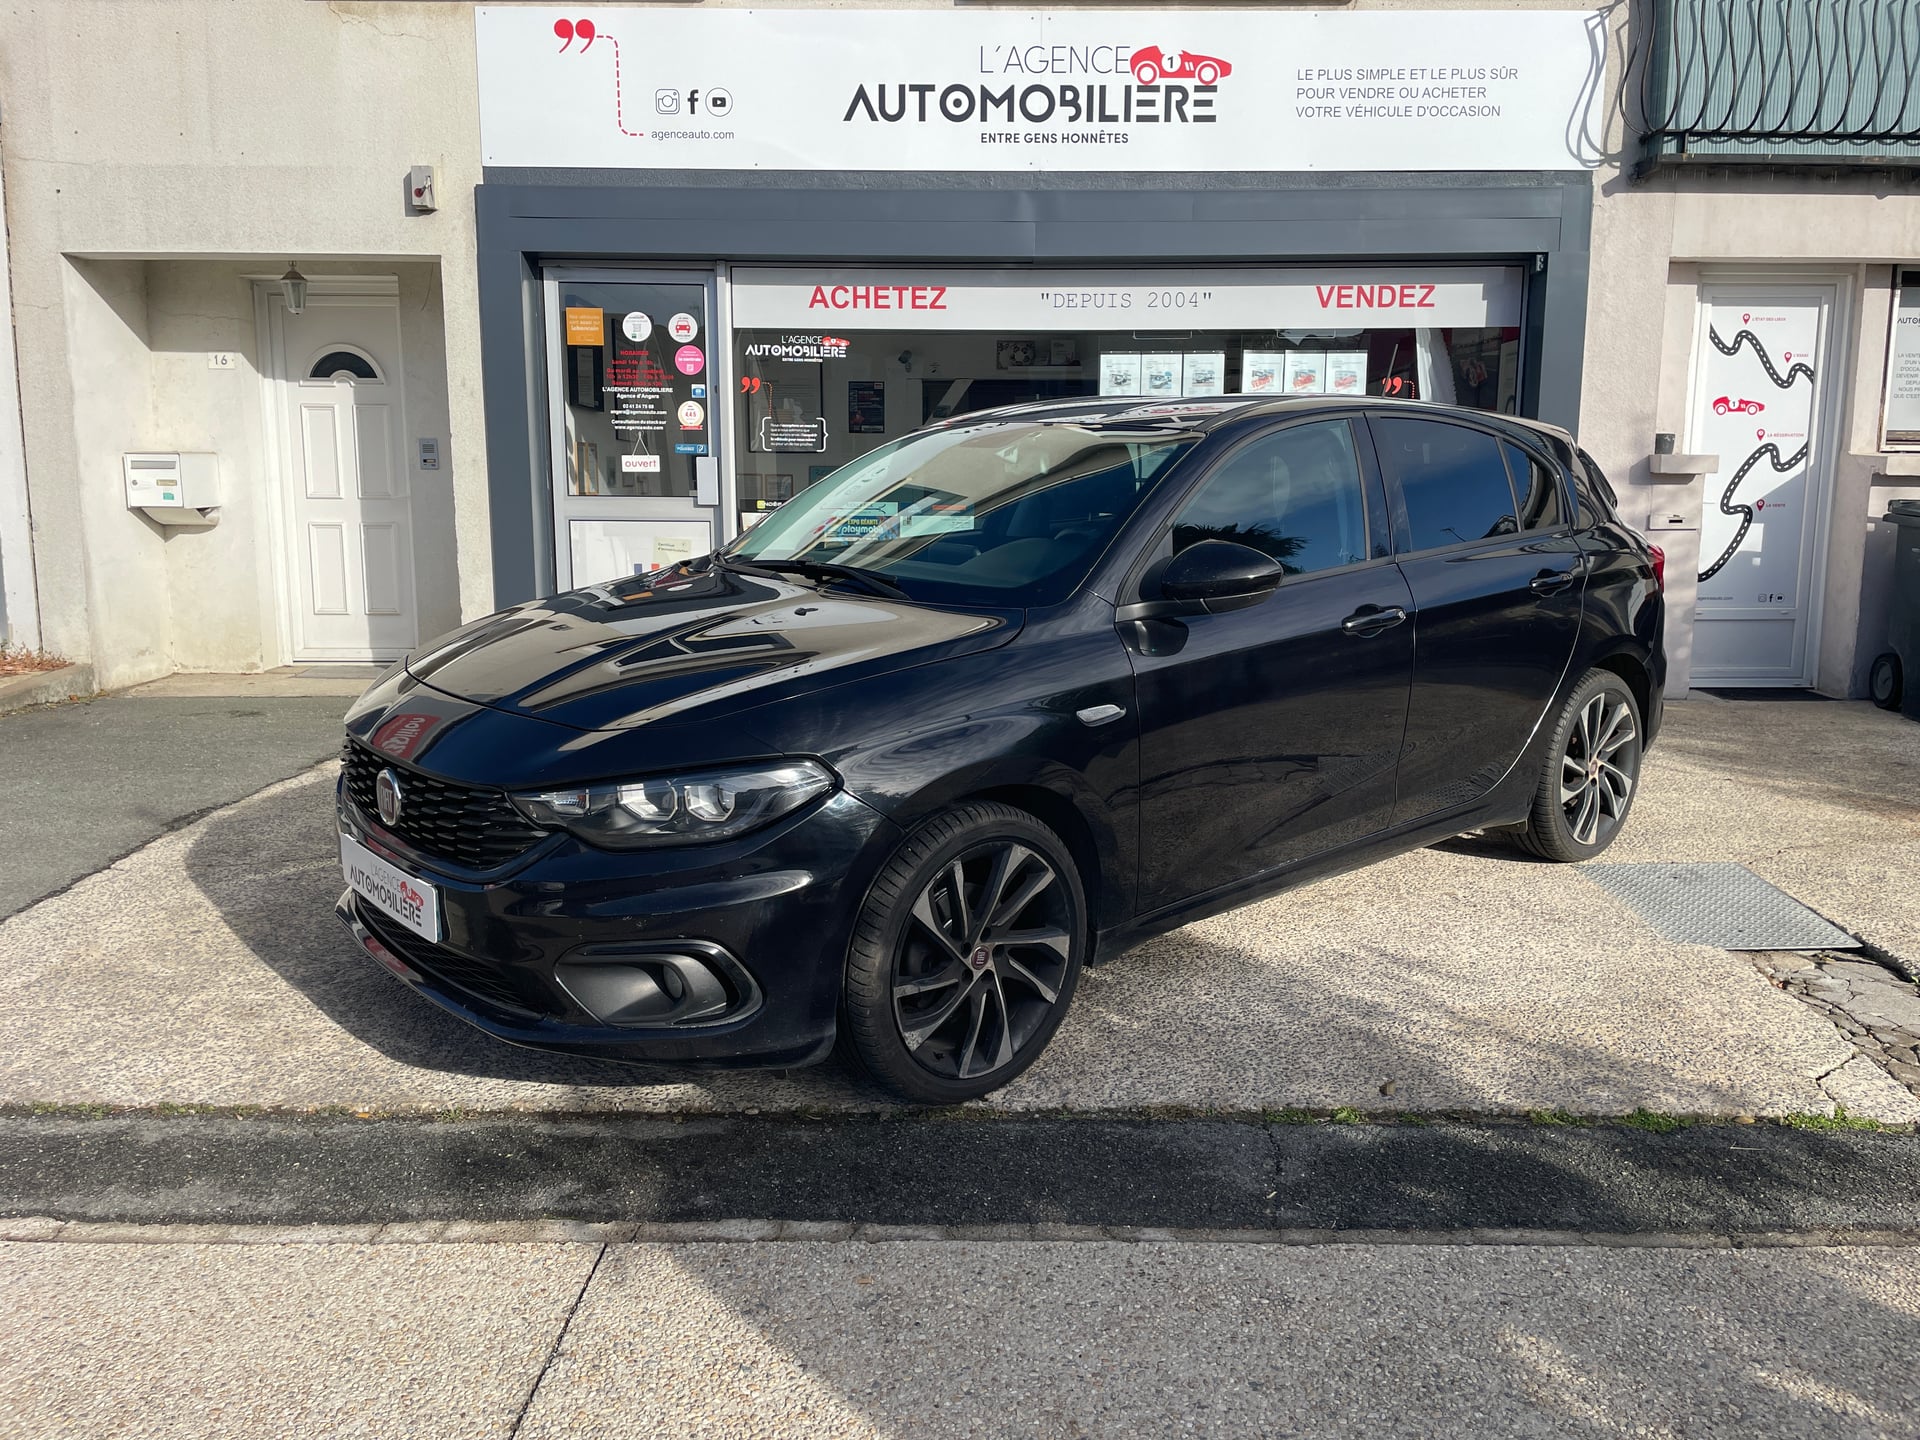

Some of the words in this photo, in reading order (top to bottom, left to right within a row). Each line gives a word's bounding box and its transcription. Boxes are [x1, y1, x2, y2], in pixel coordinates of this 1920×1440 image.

[980, 45, 1130, 74] L'AGENCE
[1297, 69, 1314, 81] LE
[1317, 69, 1353, 81] PLUS
[1355, 69, 1407, 81] SIMPLE
[1409, 69, 1428, 81] ET
[1430, 69, 1448, 81] LE
[1450, 69, 1487, 80] PLUS
[1488, 65, 1519, 80] SÛR
[1296, 86, 1335, 100] POUR
[1338, 86, 1395, 99] VENDRE
[1398, 86, 1420, 99] OU
[1421, 86, 1487, 99] ACHETER
[1295, 106, 1342, 118] VOTRE
[1345, 102, 1413, 118] VÉHICULE
[1416, 105, 1501, 118] D'OCCASION
[650, 128, 735, 141] agenceauto.com
[980, 133, 1021, 144] ENTRE
[1023, 133, 1058, 144] GENS
[1060, 130, 1129, 144] HONNÊTES
[808, 285, 947, 310] ACHETEZ
[1040, 291, 1133, 309] "DEPUIS
[1146, 291, 1212, 308] 2004"
[1315, 284, 1436, 309] VENDEZ
[1897, 317, 1920, 325] AUTO
[781, 335, 823, 344] L'AGENCE
[213, 355, 228, 366] 16
[624, 459, 657, 468] ouvert
